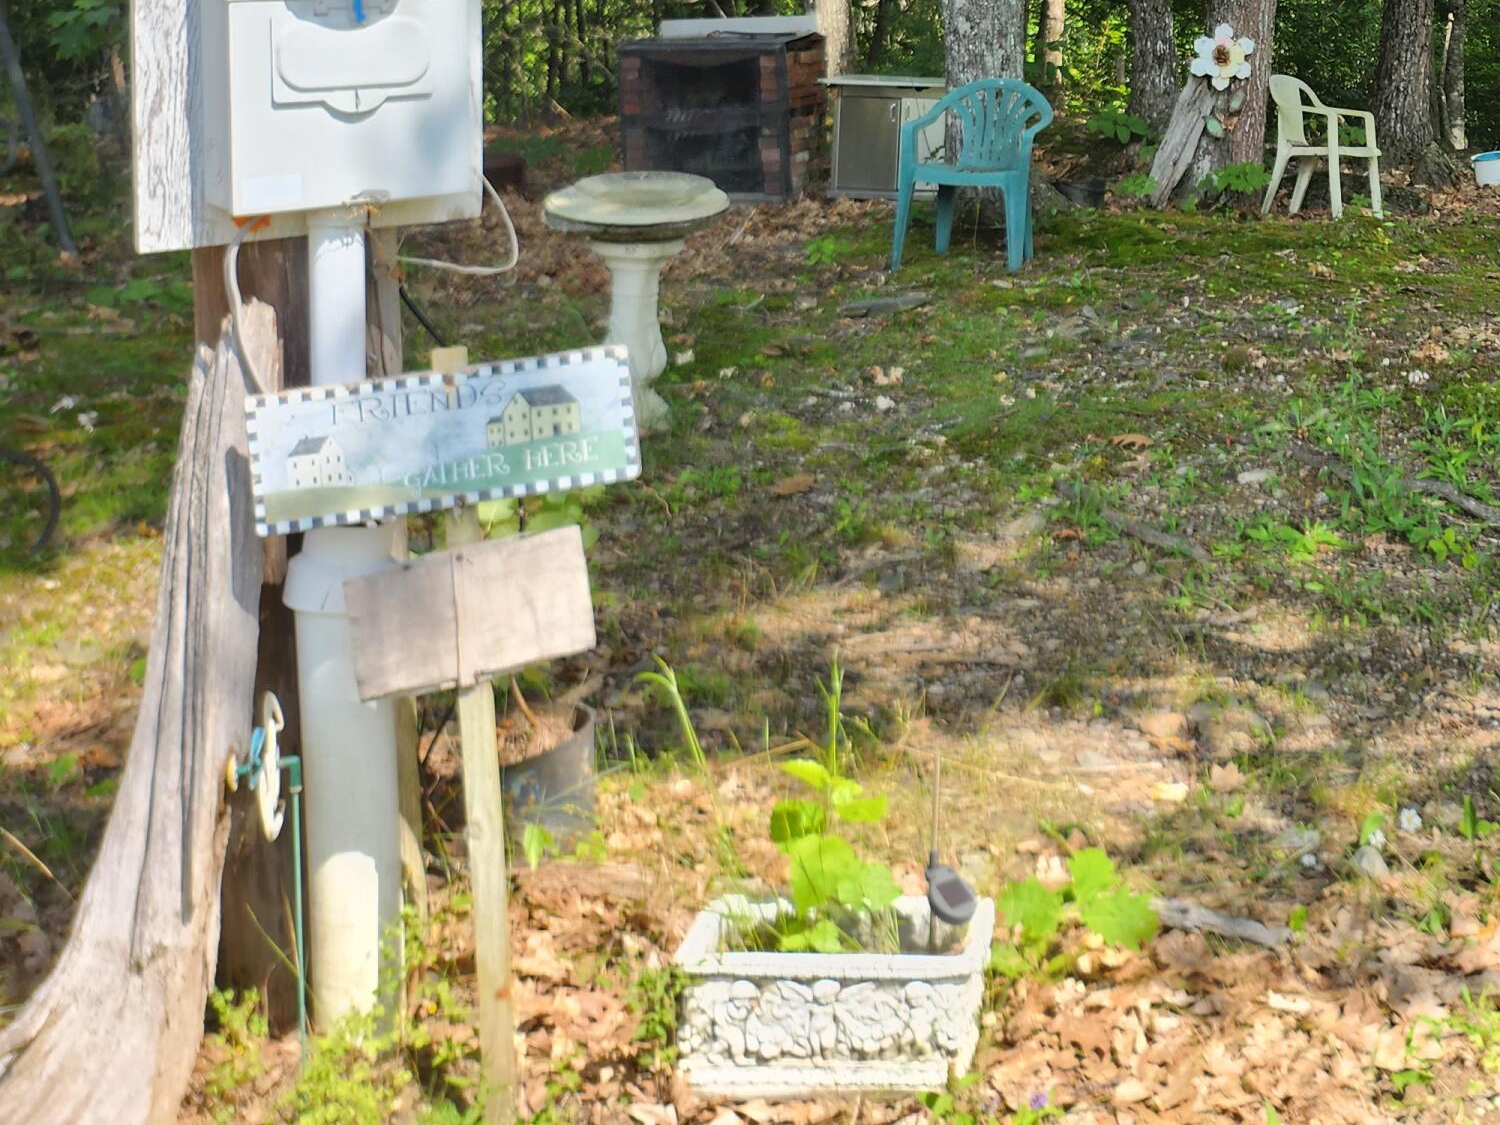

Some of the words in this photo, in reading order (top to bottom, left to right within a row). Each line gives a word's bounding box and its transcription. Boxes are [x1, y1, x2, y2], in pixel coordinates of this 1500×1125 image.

[330, 379, 507, 426] FRIENDS
[403, 451, 511, 498] GATHER
[524, 436, 600, 472] HERE
